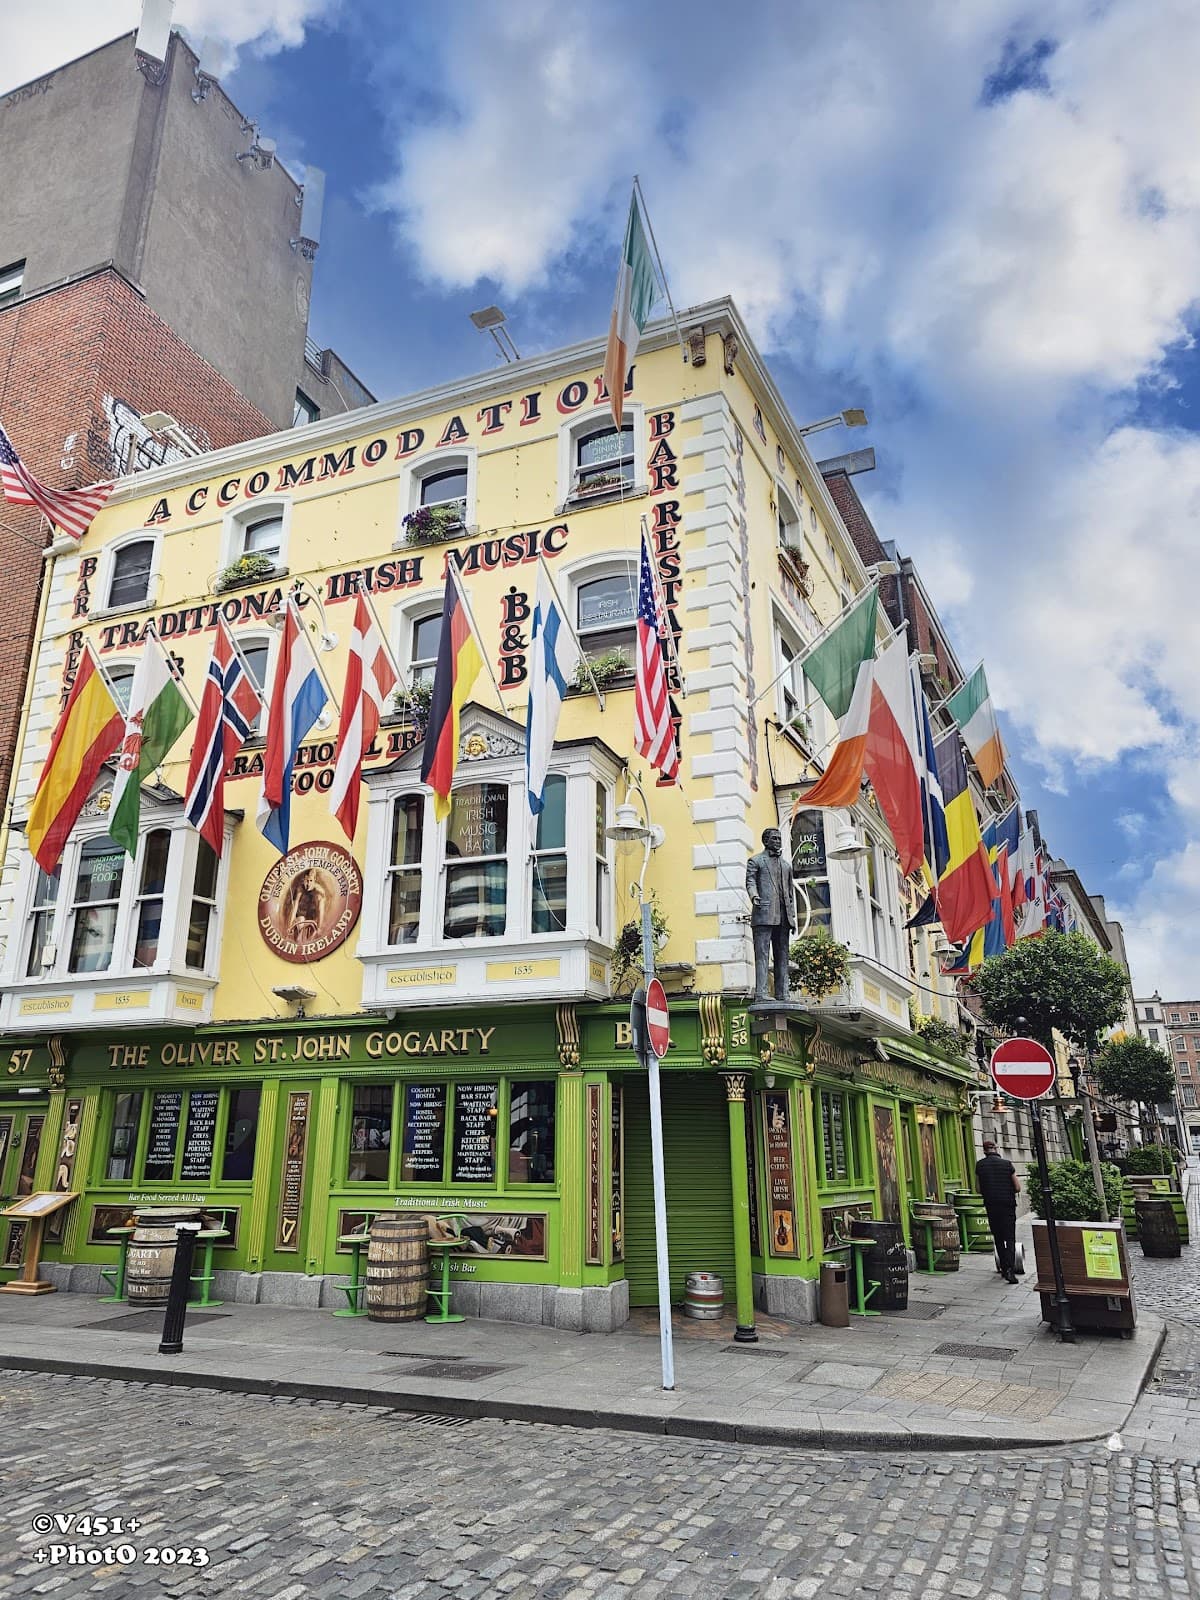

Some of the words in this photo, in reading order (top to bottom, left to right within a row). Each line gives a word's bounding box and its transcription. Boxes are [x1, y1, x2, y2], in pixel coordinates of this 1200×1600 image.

[588, 432, 627, 449] PRIVATE
[648, 411, 680, 496] BAR
[324, 556, 423, 606] IRISH
[441, 523, 569, 580] MUSIC
[71, 557, 98, 619] BAR
[499, 591, 531, 690] B&B
[455, 793, 506, 806] TRADITIONAL
[466, 808, 494, 821] IRISH
[459, 822, 498, 836] MUSIC
[465, 838, 490, 851] BAR
[92, 862, 119, 873] IRISH
[798, 856, 824, 866] MUSIC
[91, 871, 119, 883] FOOD
[302, 846, 330, 860] JOHN
[329, 850, 360, 895] GOGARTY
[260, 916, 299, 956] DUBLIN
[301, 909, 353, 956] IRELAND
[731, 1013, 747, 1030] 57
[108, 1044, 150, 1069] THE
[160, 1040, 241, 1067] OLIVER
[254, 1037, 287, 1063] ST.
[291, 1034, 351, 1062] JOHN
[365, 1026, 496, 1060] GOGARTY
[731, 1031, 747, 1048] 58
[7, 1049, 33, 1075] 57
[142, 1194, 157, 1202] Food
[158, 1194, 179, 1202] Served
[181, 1194, 190, 1202] All
[192, 1194, 206, 1203] Day
[394, 1197, 438, 1207] Traditional
[440, 1199, 460, 1208] Irish
[464, 1199, 488, 1208] Music
[462, 1263, 476, 1273] Bar
